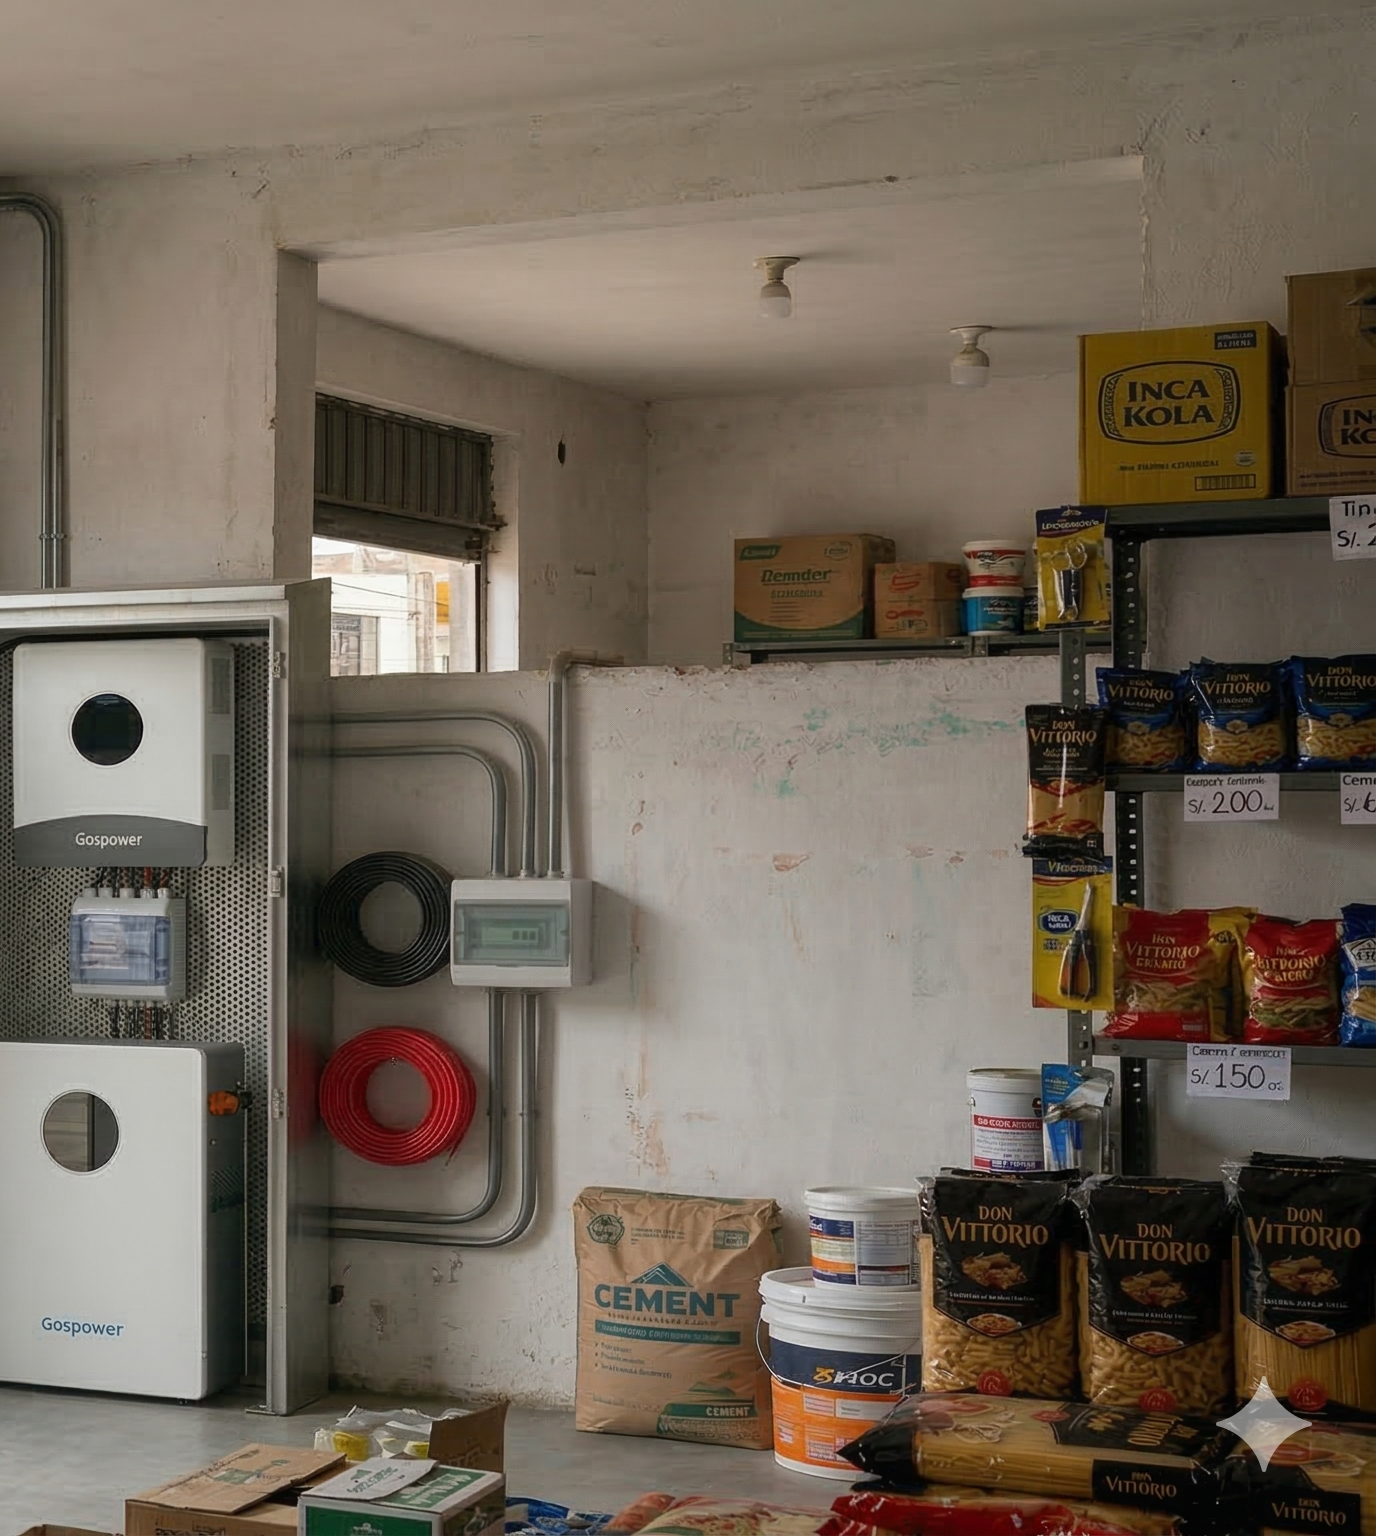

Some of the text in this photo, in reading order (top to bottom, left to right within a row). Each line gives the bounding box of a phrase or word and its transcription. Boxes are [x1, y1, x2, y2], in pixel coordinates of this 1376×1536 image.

[1127, 379, 1211, 403] INCA
[1124, 404, 1216, 428] KOLA
[1343, 409, 1376, 425] IN
[1341, 501, 1376, 517] Tin
[1212, 790, 1263, 814] 200
[75, 832, 143, 849] Gospower
[1215, 1062, 1266, 1089] 150
[978, 1205, 1013, 1221] DON
[1287, 1206, 1323, 1223] DON
[941, 1216, 1049, 1248] VITTORIO
[1137, 1223, 1174, 1238] DON
[1247, 1217, 1361, 1250] VITTORIO
[1099, 1234, 1211, 1265] VITTORIO
[594, 1284, 740, 1318] CEMENT
[41, 1317, 124, 1337] Gospower
[706, 1406, 751, 1417] CEMENT
[1271, 1501, 1347, 1527] VITTORIO
